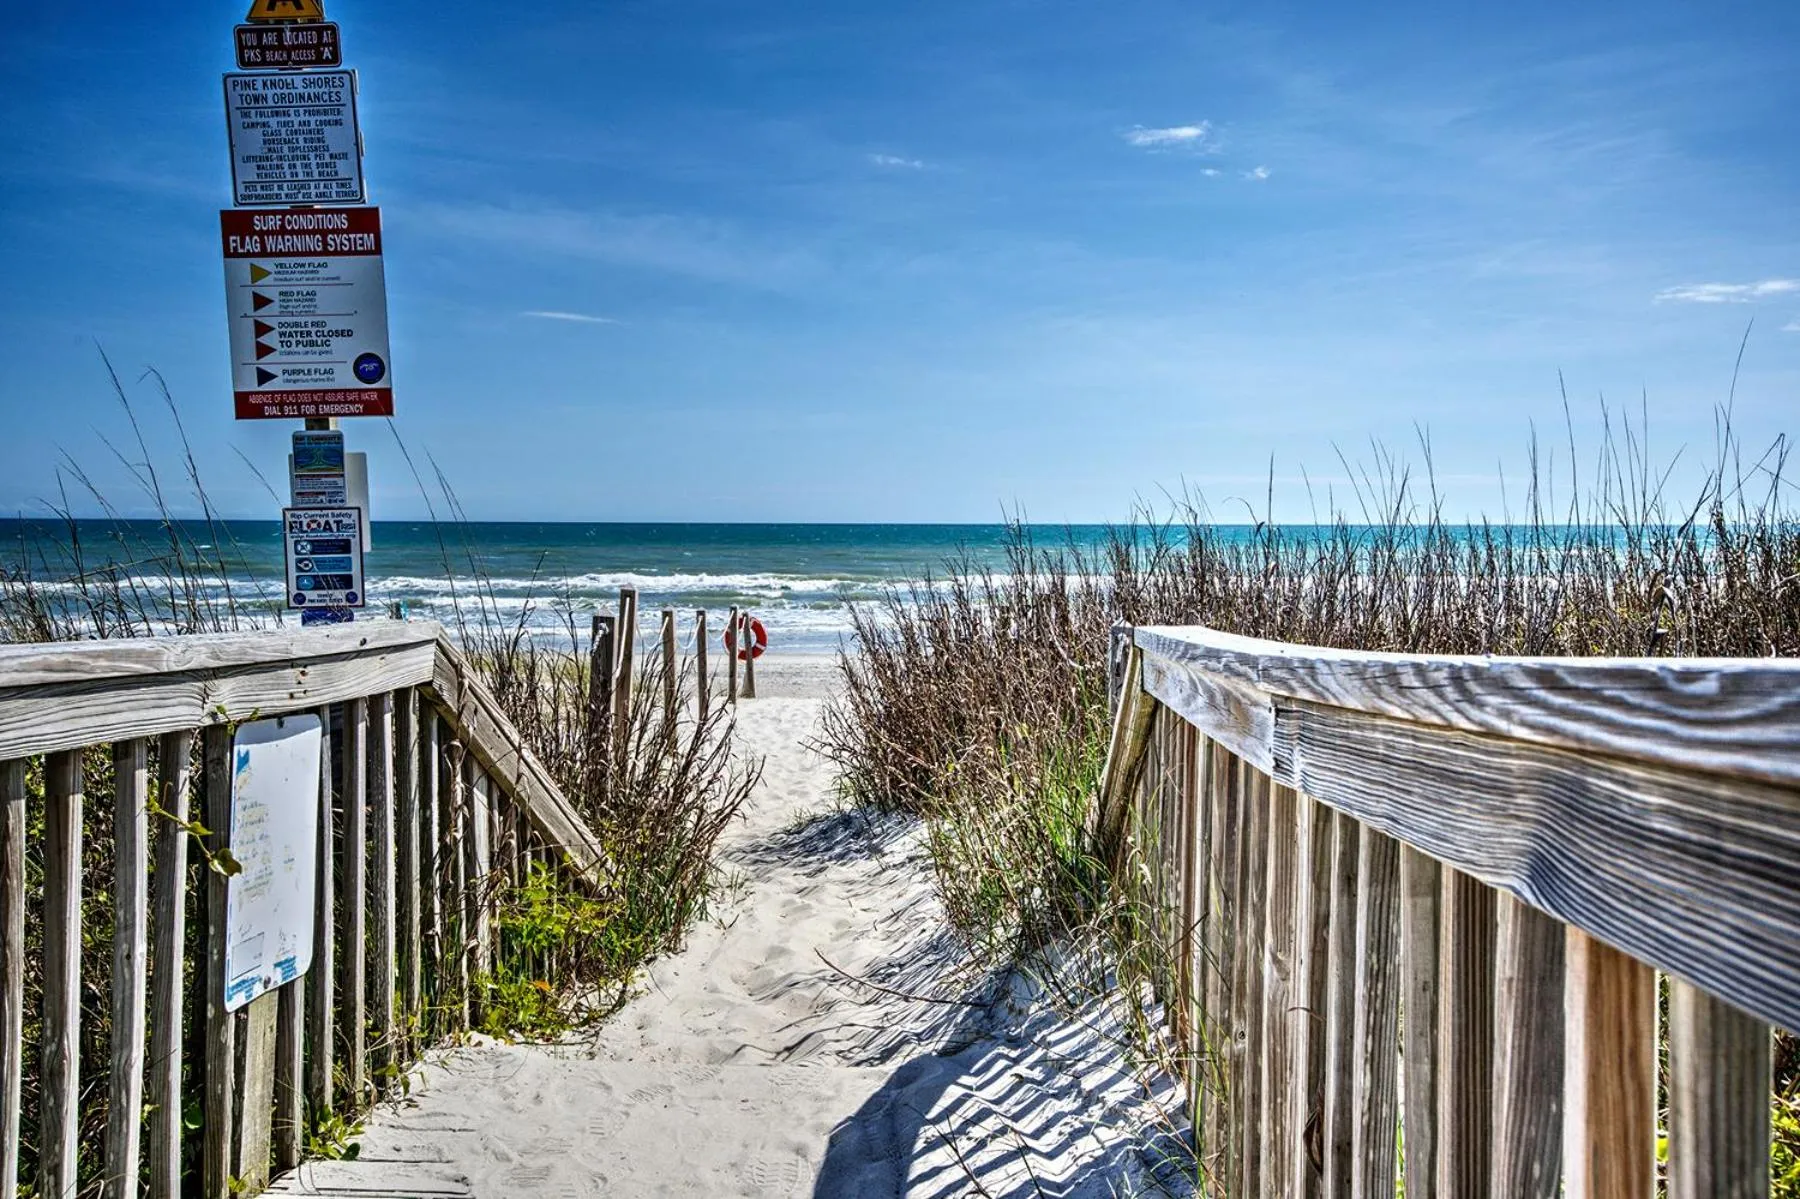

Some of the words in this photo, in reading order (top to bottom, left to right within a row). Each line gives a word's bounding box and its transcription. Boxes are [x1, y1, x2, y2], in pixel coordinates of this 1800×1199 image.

[241, 33, 257, 46] YOU
[262, 32, 278, 45] ARE
[283, 31, 318, 45] LOCATED
[244, 49, 260, 62] PKS
[266, 50, 287, 61] BEACH
[291, 50, 315, 60] ACCESS
[232, 80, 258, 91] PINE
[263, 78, 298, 90] KNOLL
[302, 77, 344, 88] SHORES
[239, 93, 268, 105] TOWN
[272, 91, 341, 104] ORDINANCES
[240, 110, 252, 118] THE
[255, 109, 291, 118] FOLLOWING
[294, 109, 300, 117] IS
[303, 108, 343, 117] PROHIBITED:
[242, 121, 270, 129] CAMPING,
[277, 120, 294, 128] FIRES
[315, 119, 343, 127] COOKING
[285, 128, 324, 136] CONTAINERS
[263, 137, 299, 145] HORSEBACK
[304, 136, 325, 144] RIDING
[288, 144, 329, 153] TOPLESSNESS
[330, 152, 348, 160] WASTE
[256, 163, 284, 171] WALKING
[288, 162, 296, 170] ON
[300, 162, 312, 170] THE
[316, 161, 336, 169] DUNES
[256, 171, 286, 180] VEHICLES
[290, 171, 299, 179] ON
[302, 170, 314, 178] THE
[318, 170, 339, 178] BEACH
[244, 185, 257, 193] PETS
[260, 184, 274, 192] MUST
[287, 183, 311, 191] LEASHED
[314, 182, 321, 190] AT
[323, 182, 333, 190] ALL
[335, 181, 352, 189] TIMES
[285, 192, 300, 200] MUST
[302, 191, 312, 199] USE
[315, 190, 332, 198] ANKLE
[253, 215, 282, 231] SURF
[285, 214, 348, 230] CONDITIONS
[229, 235, 261, 253] FLAG
[265, 234, 322, 252] WARNING
[327, 233, 375, 251] SYSTEM
[278, 330, 312, 338] WATER
[315, 329, 353, 337] CLOSED
[279, 340, 292, 348] TO
[296, 339, 331, 347] PUBLIC
[282, 368, 313, 376] PURPLE
[249, 395, 272, 403] ABSENCE
[274, 394, 281, 403] OF
[283, 394, 296, 403] FLAG
[298, 394, 312, 402] DOES
[313, 394, 323, 402] NOT
[325, 393, 345, 401] ASSURE
[346, 392, 359, 400] SAFE
[361, 392, 378, 400] WATER
[264, 406, 281, 415] DIAL
[285, 405, 299, 415] 911
[301, 405, 316, 414] FOR
[319, 403, 364, 414] EMERGENCY
